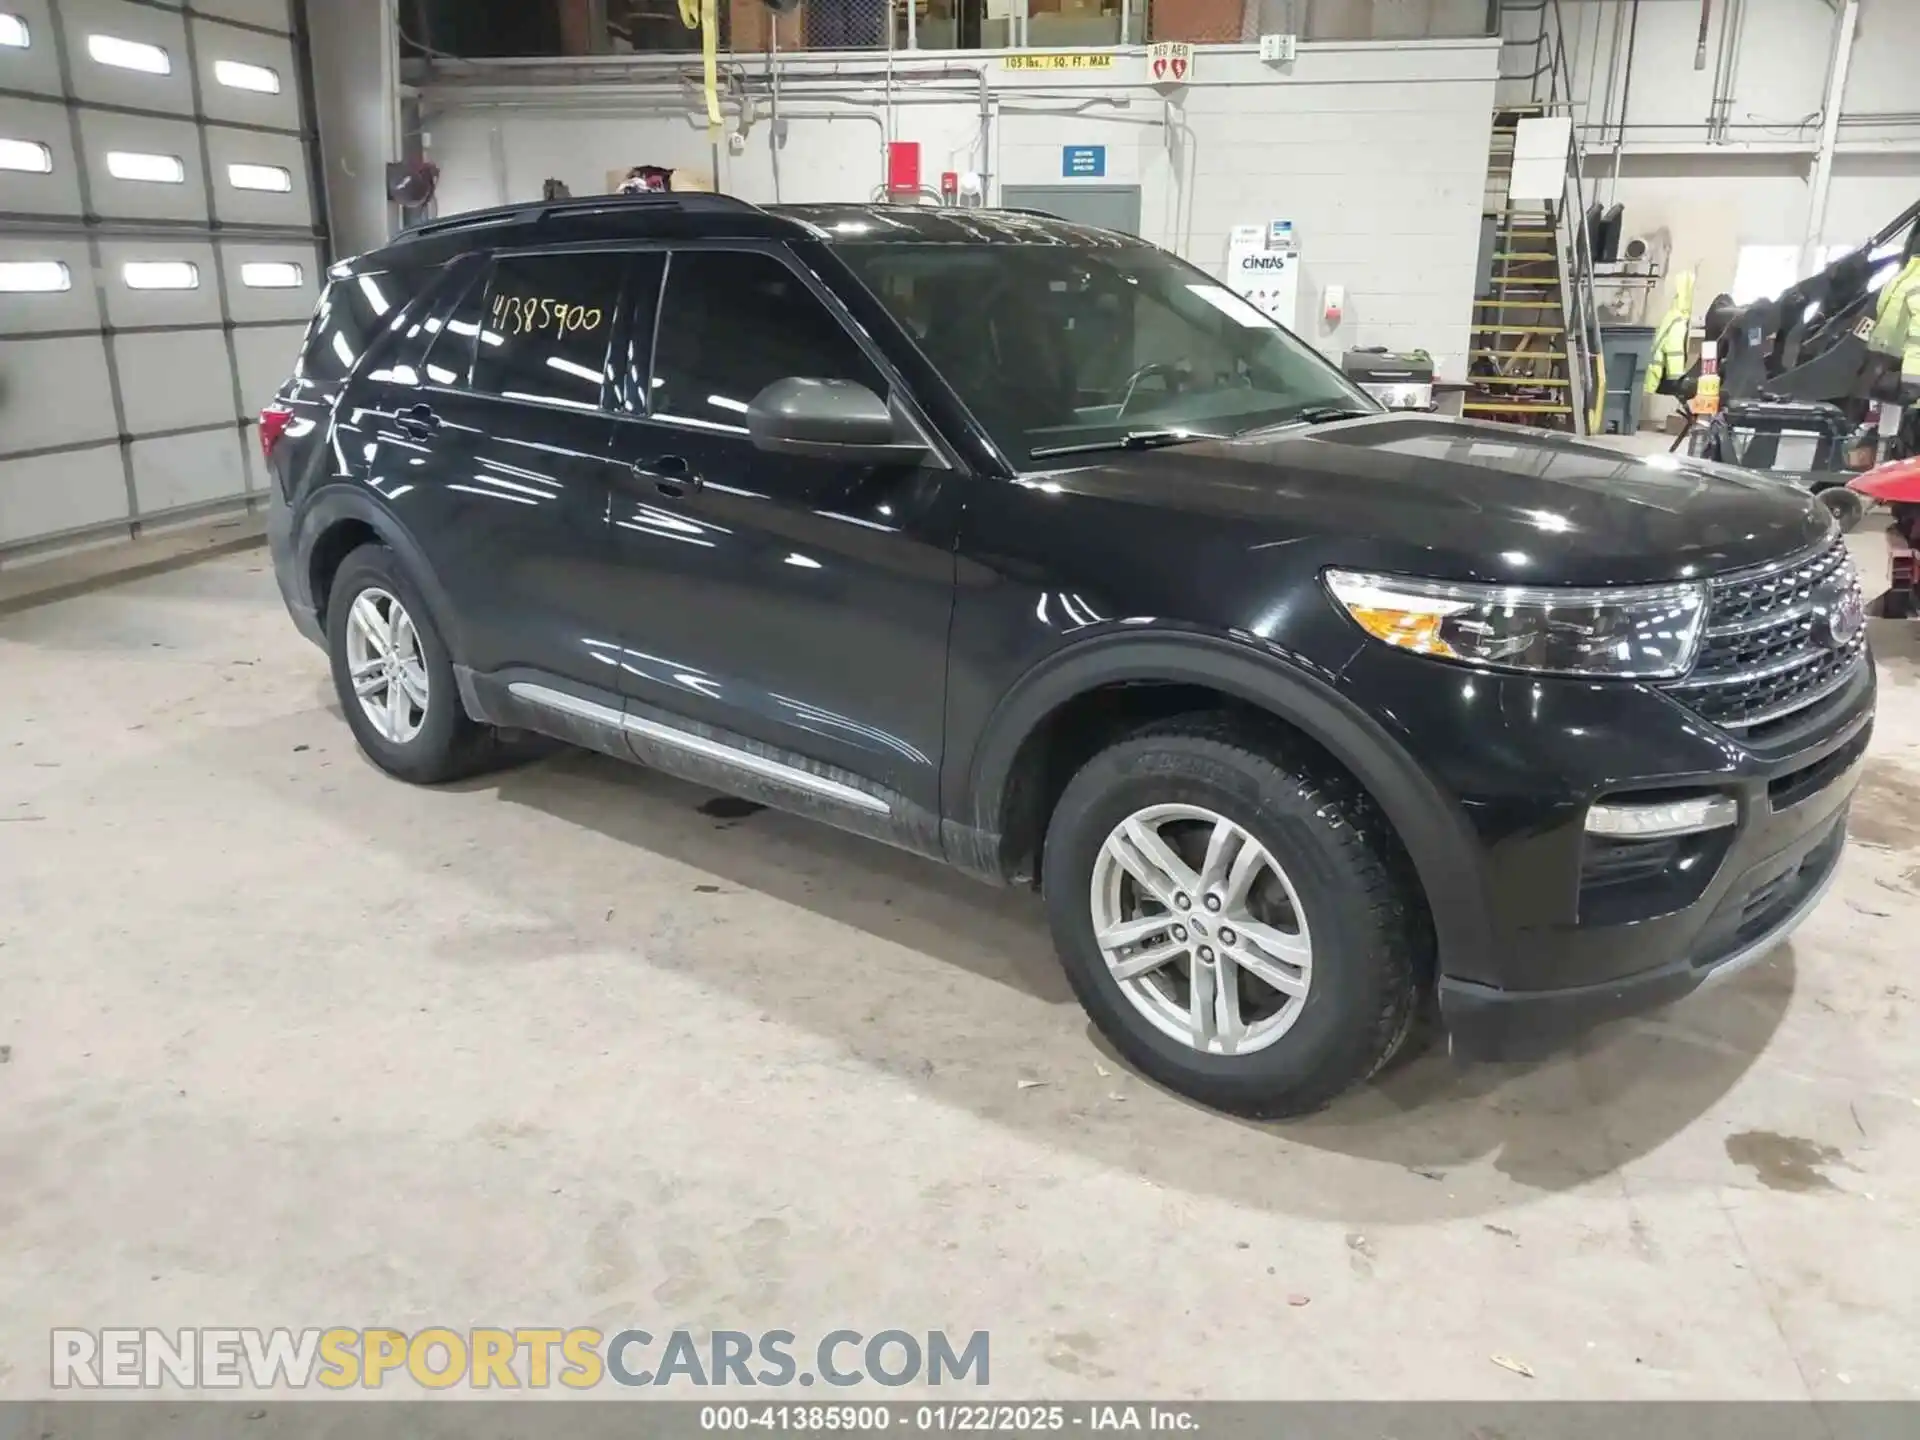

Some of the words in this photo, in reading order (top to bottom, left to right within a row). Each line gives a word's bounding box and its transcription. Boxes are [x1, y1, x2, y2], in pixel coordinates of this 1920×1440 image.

[1005, 56, 1022, 68] 105
[1089, 55, 1111, 66] MAX
[492, 294, 601, 341] 41385900
